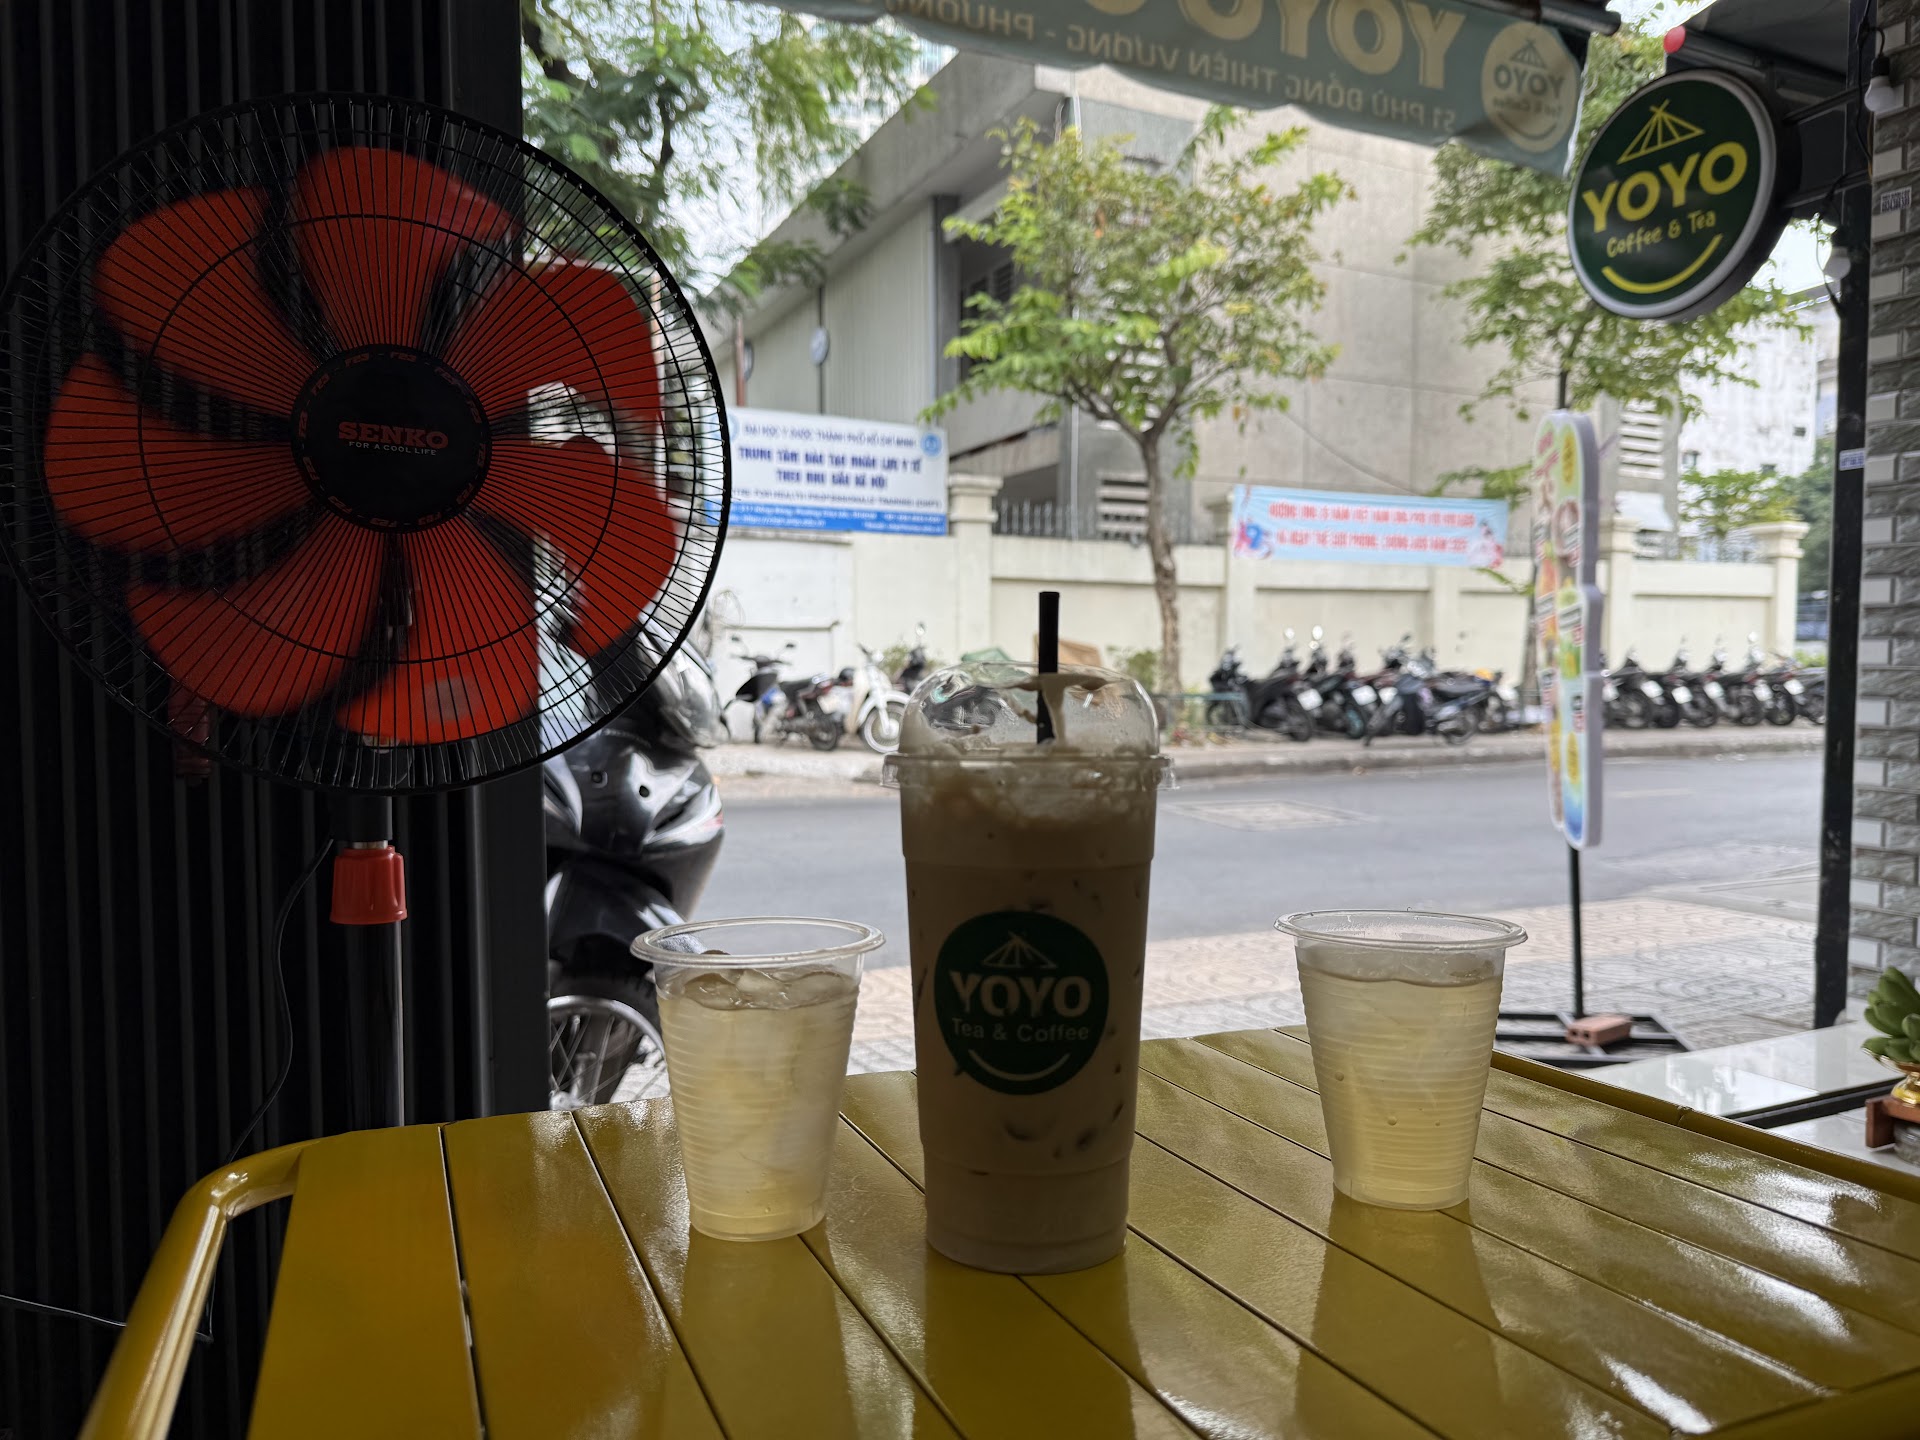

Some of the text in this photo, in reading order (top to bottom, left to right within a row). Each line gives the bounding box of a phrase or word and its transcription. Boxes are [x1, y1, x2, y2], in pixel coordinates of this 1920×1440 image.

[1582, 141, 1748, 233] YOYO
[1607, 210, 1716, 258] Coffee & Tea
[338, 421, 449, 449] SENKO
[349, 441, 369, 449] FOR
[383, 444, 411, 454] COOL
[415, 447, 437, 456] LIFE
[949, 970, 1092, 1018] YOYO
[952, 1017, 1089, 1043] Tea & Coffee
